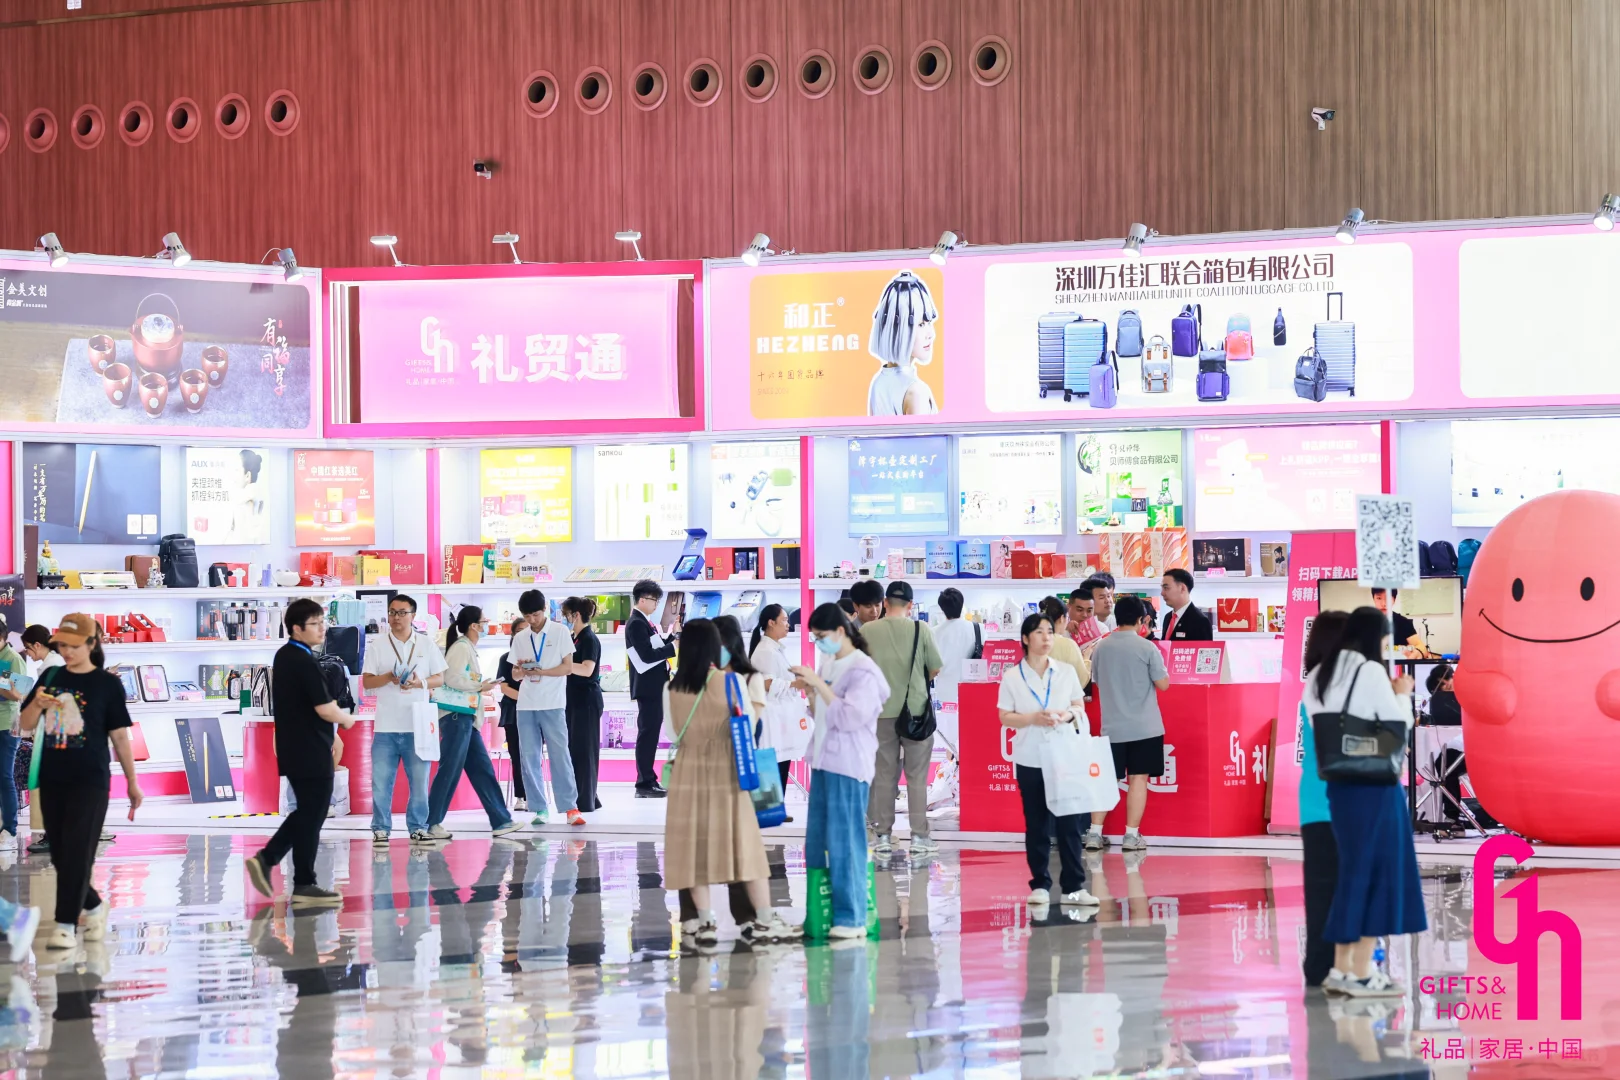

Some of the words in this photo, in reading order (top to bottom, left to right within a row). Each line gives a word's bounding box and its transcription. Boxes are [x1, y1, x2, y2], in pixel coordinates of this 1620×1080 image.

[1055, 253, 1335, 291] 深圳万佳汇联合箱包有限公司
[756, 333, 860, 354] HEZHENG
[470, 332, 624, 384] 礼贸通
[191, 460, 208, 468] AUX
[1109, 454, 1179, 466] 贝师傅食品有限公司
[1298, 566, 1358, 581] 扫码下载AP
[992, 772, 1011, 780] HOME
